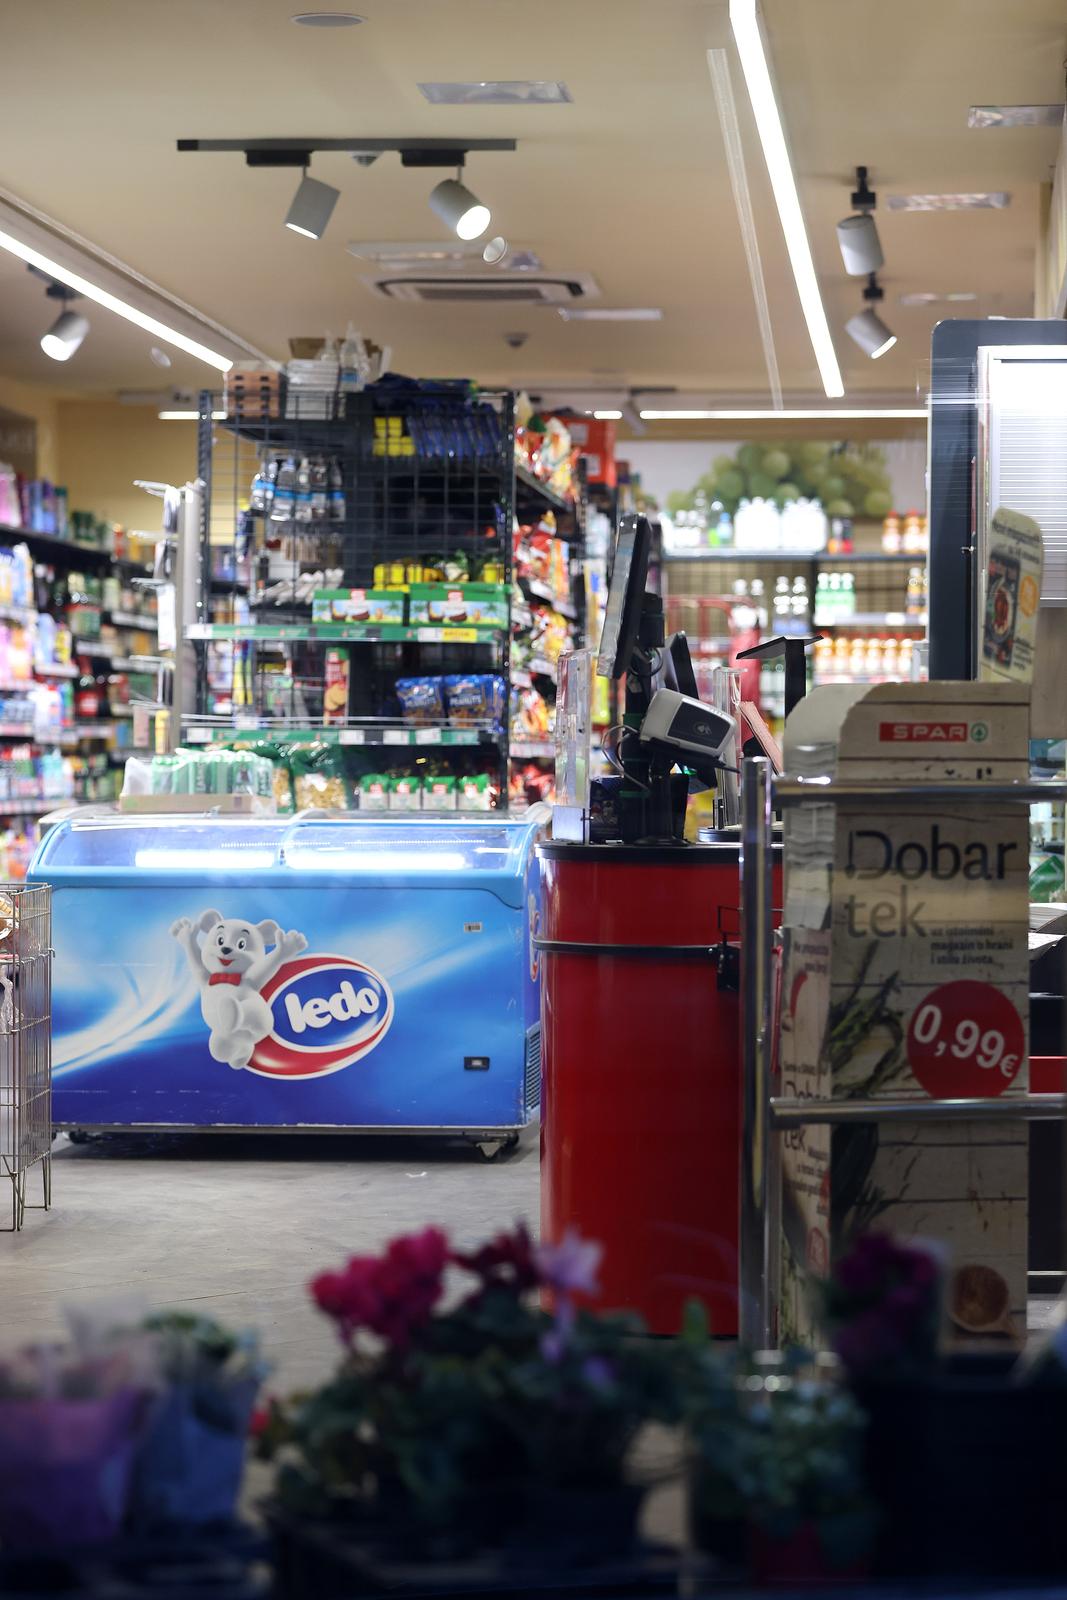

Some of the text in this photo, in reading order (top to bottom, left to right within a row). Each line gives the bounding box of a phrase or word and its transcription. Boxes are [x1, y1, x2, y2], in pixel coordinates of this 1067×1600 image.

[892, 725, 965, 740] SPAR
[844, 825, 1018, 881] Dobar
[844, 885, 928, 939] tek
[931, 940, 975, 952] magazin
[985, 938, 1014, 950] hrani
[283, 980, 380, 1034] ledo
[913, 1004, 1018, 1078] 0,99€
